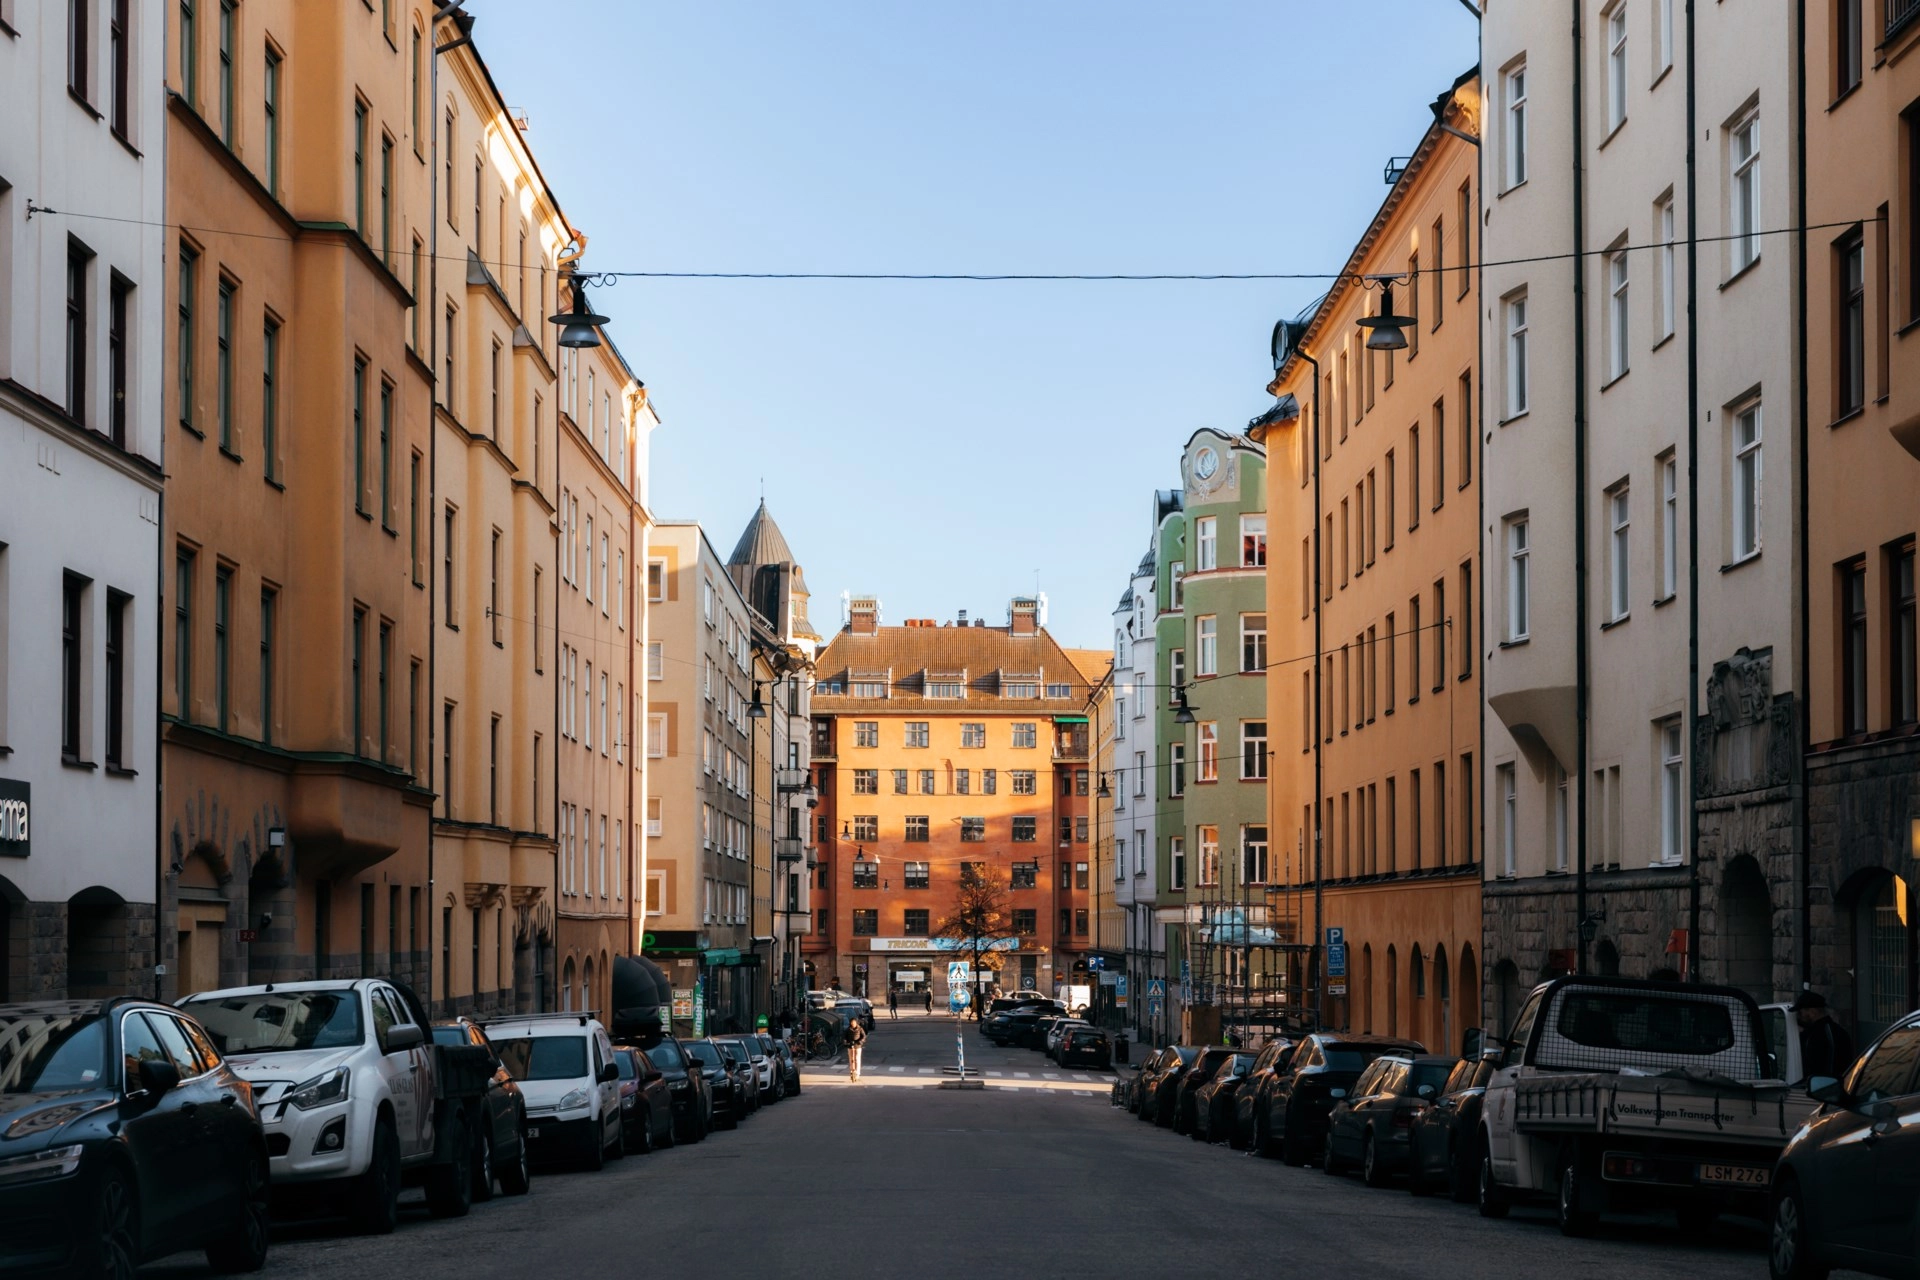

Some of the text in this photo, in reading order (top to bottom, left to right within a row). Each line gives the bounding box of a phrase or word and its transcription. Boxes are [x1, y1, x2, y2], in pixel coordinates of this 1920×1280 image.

[0, 799, 28, 841] ma
[1331, 929, 1340, 943] P
[1089, 960, 1096, 968] P
[1118, 976, 1125, 985] P
[1617, 1103, 1735, 1121] Volkswagen Transporter
[1705, 1166, 1764, 1182] LSM 276
